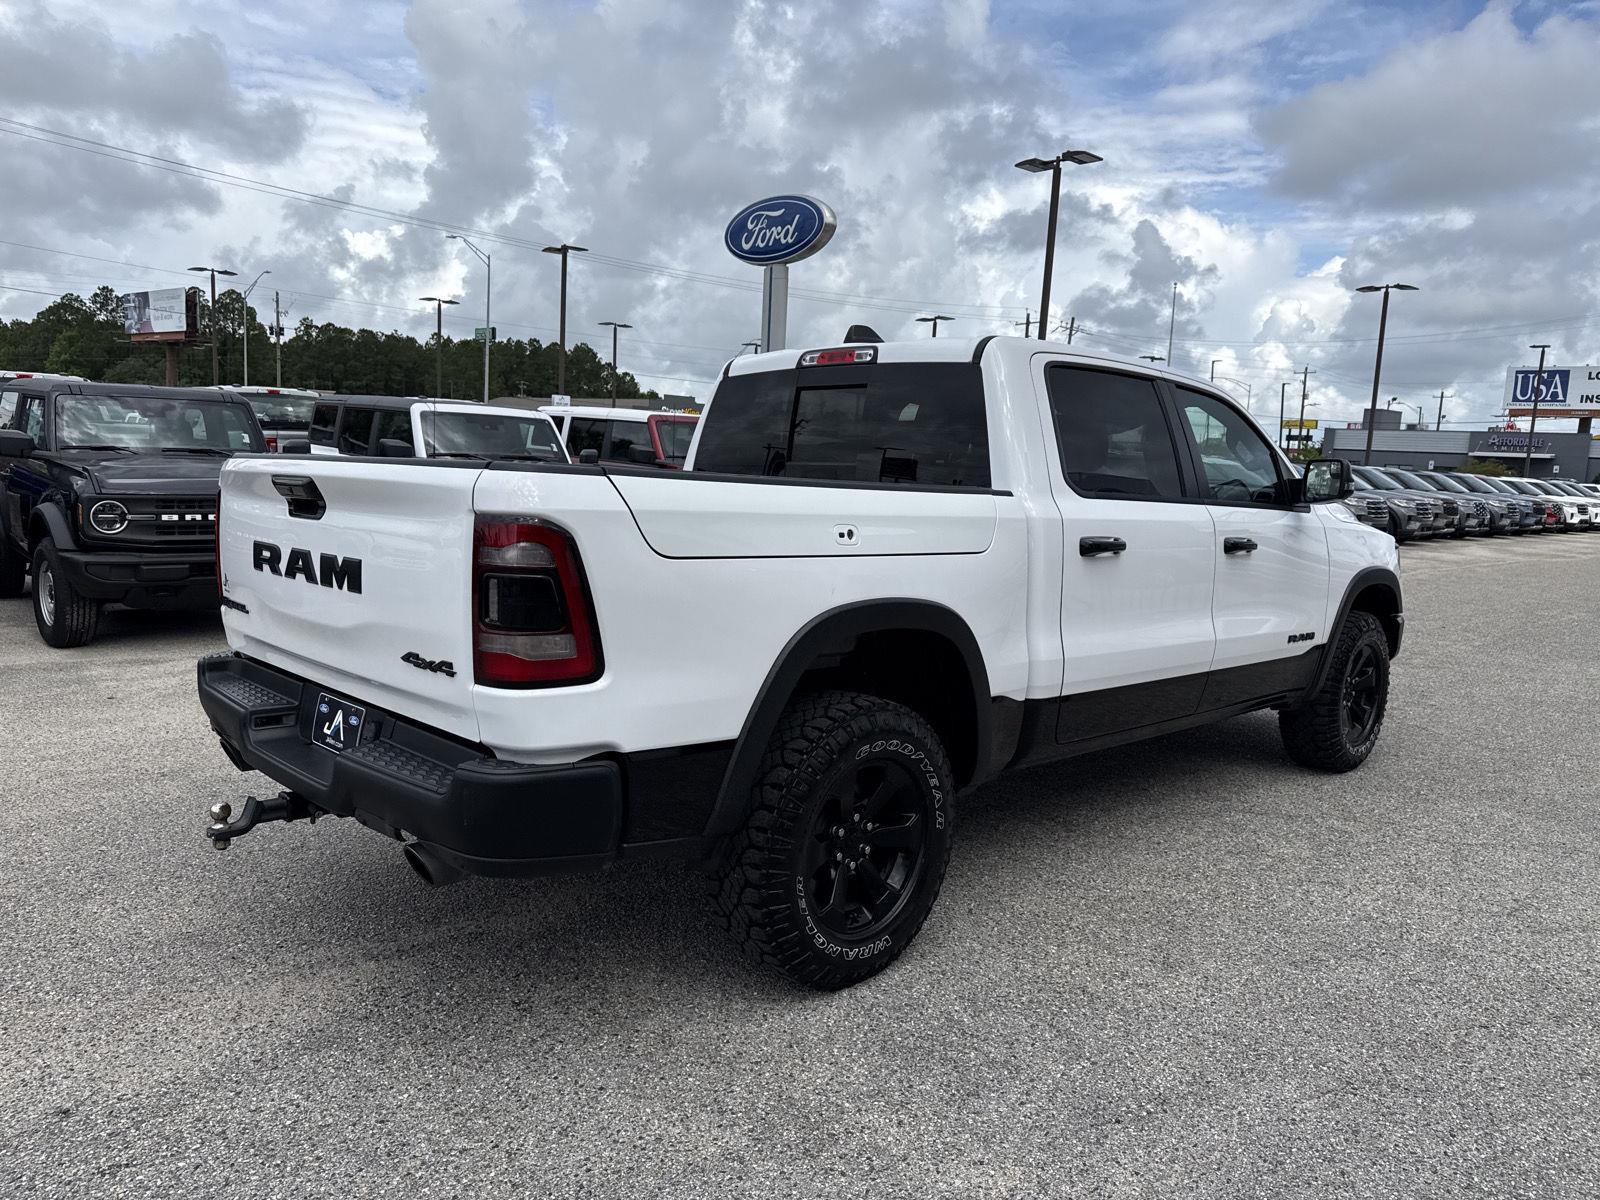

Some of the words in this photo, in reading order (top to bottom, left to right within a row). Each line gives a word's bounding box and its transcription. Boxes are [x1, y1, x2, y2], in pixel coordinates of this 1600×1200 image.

[741, 208, 800, 250] Ford
[1516, 373, 1565, 401] USA
[253, 540, 362, 594] RAM
[1287, 631, 1316, 644] RAM
[855, 740, 945, 830] GOODYEAR
[796, 876, 892, 960] WRANGLER
